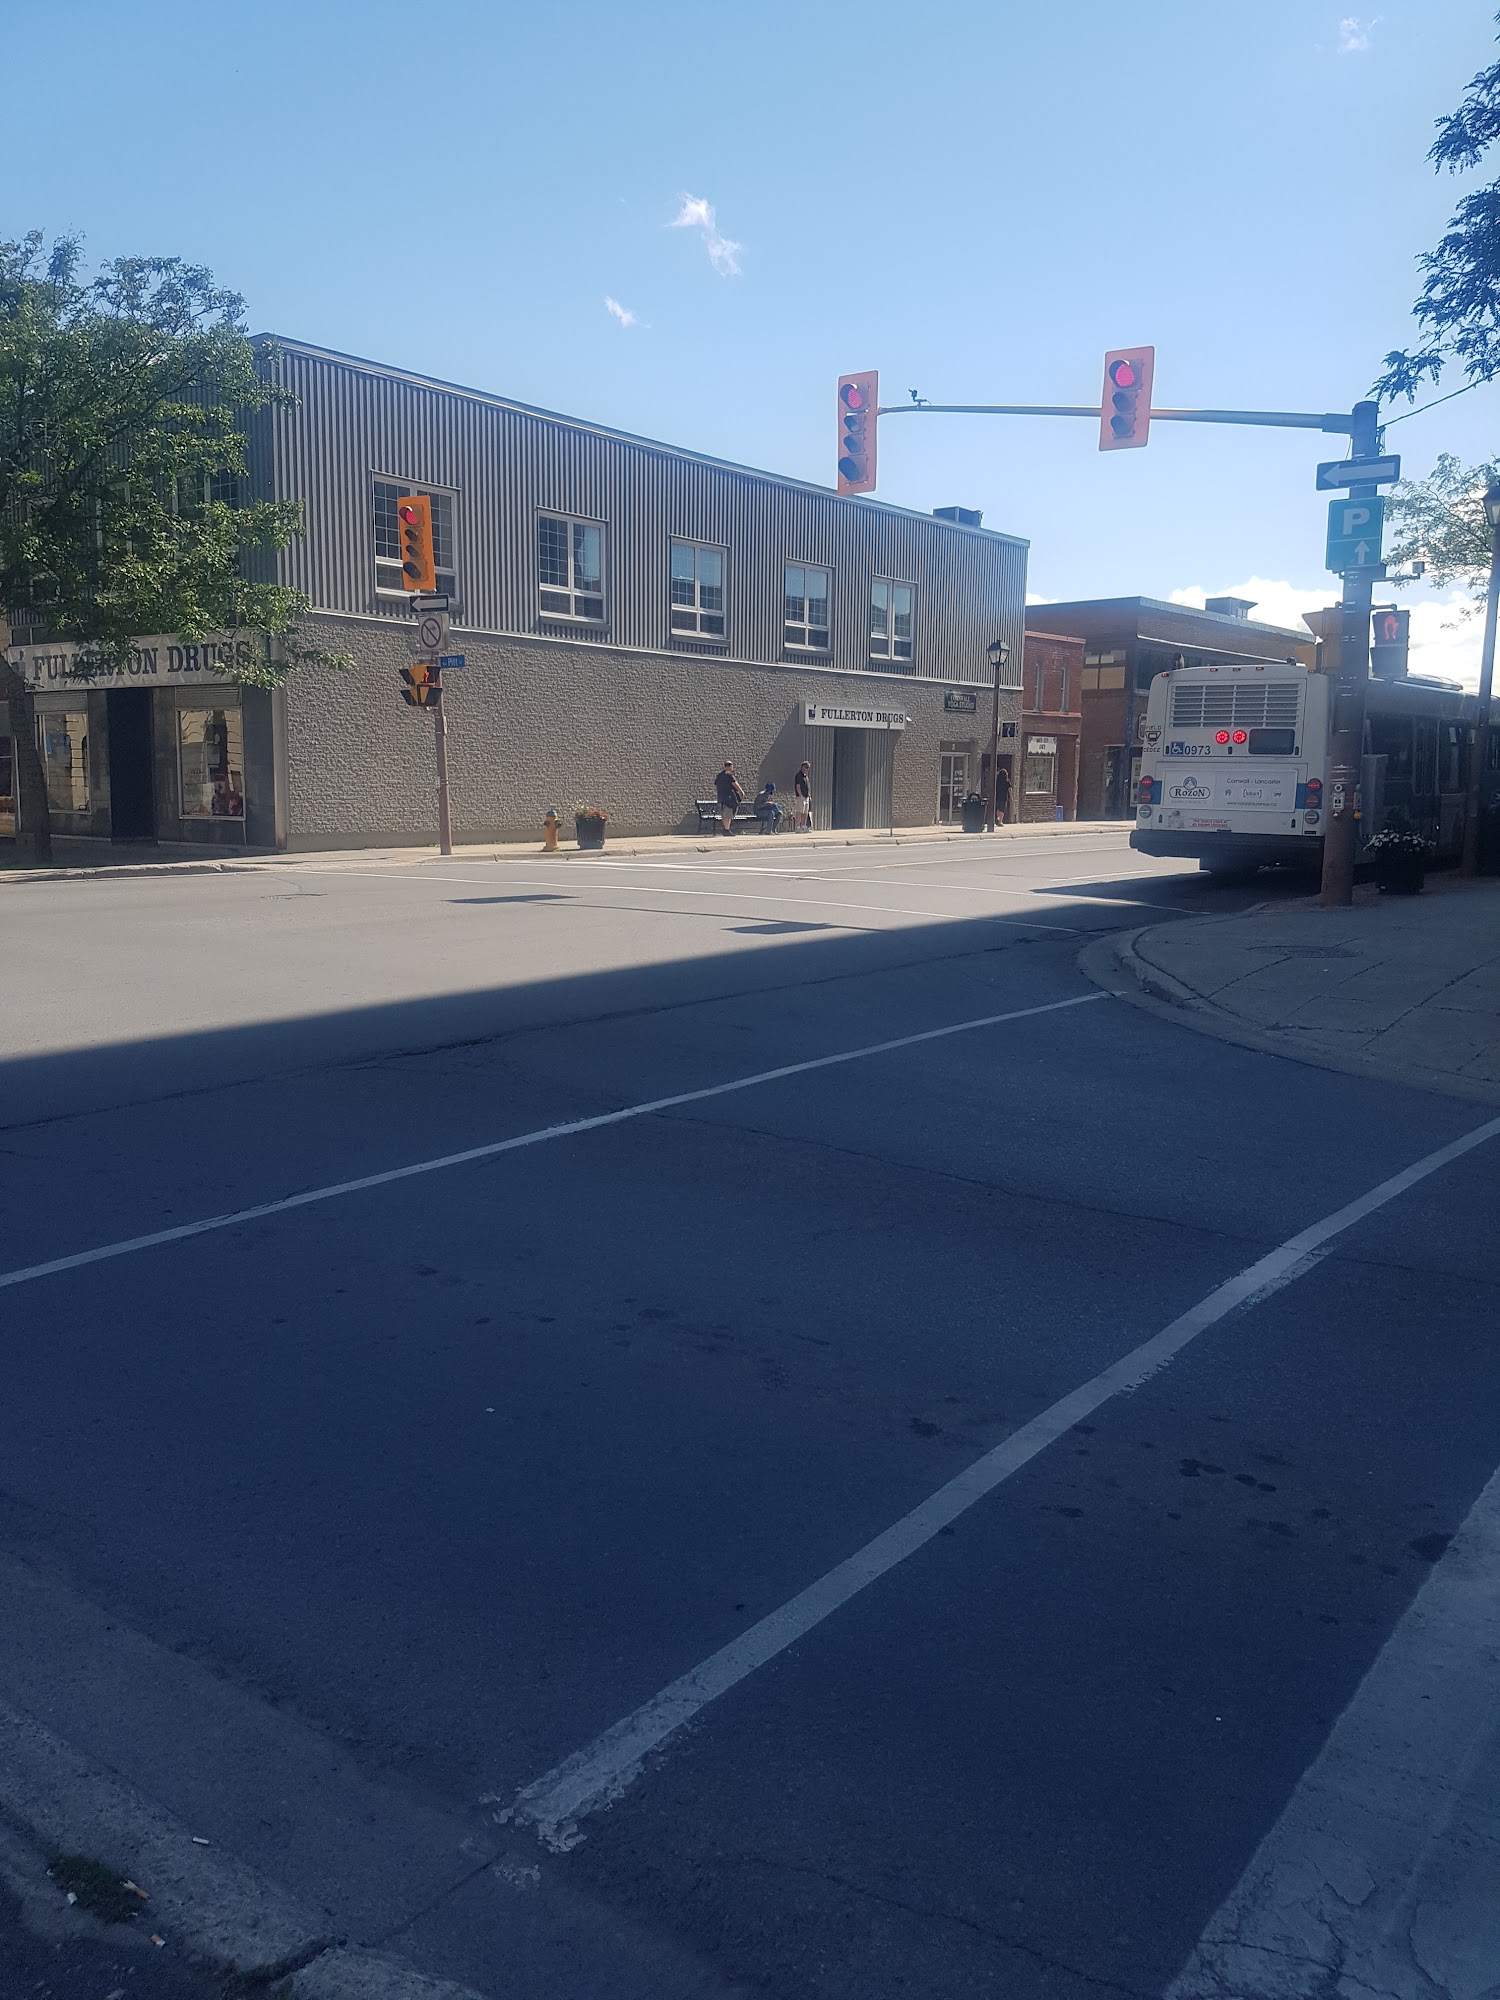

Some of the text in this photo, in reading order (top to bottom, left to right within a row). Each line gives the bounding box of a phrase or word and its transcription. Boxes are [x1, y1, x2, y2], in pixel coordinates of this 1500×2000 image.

[1343, 507, 1370, 535] P
[166, 641, 251, 673] DRUGS
[821, 708, 904, 724] FULLERTON DRUGS
[1185, 745, 1211, 755] 0973
